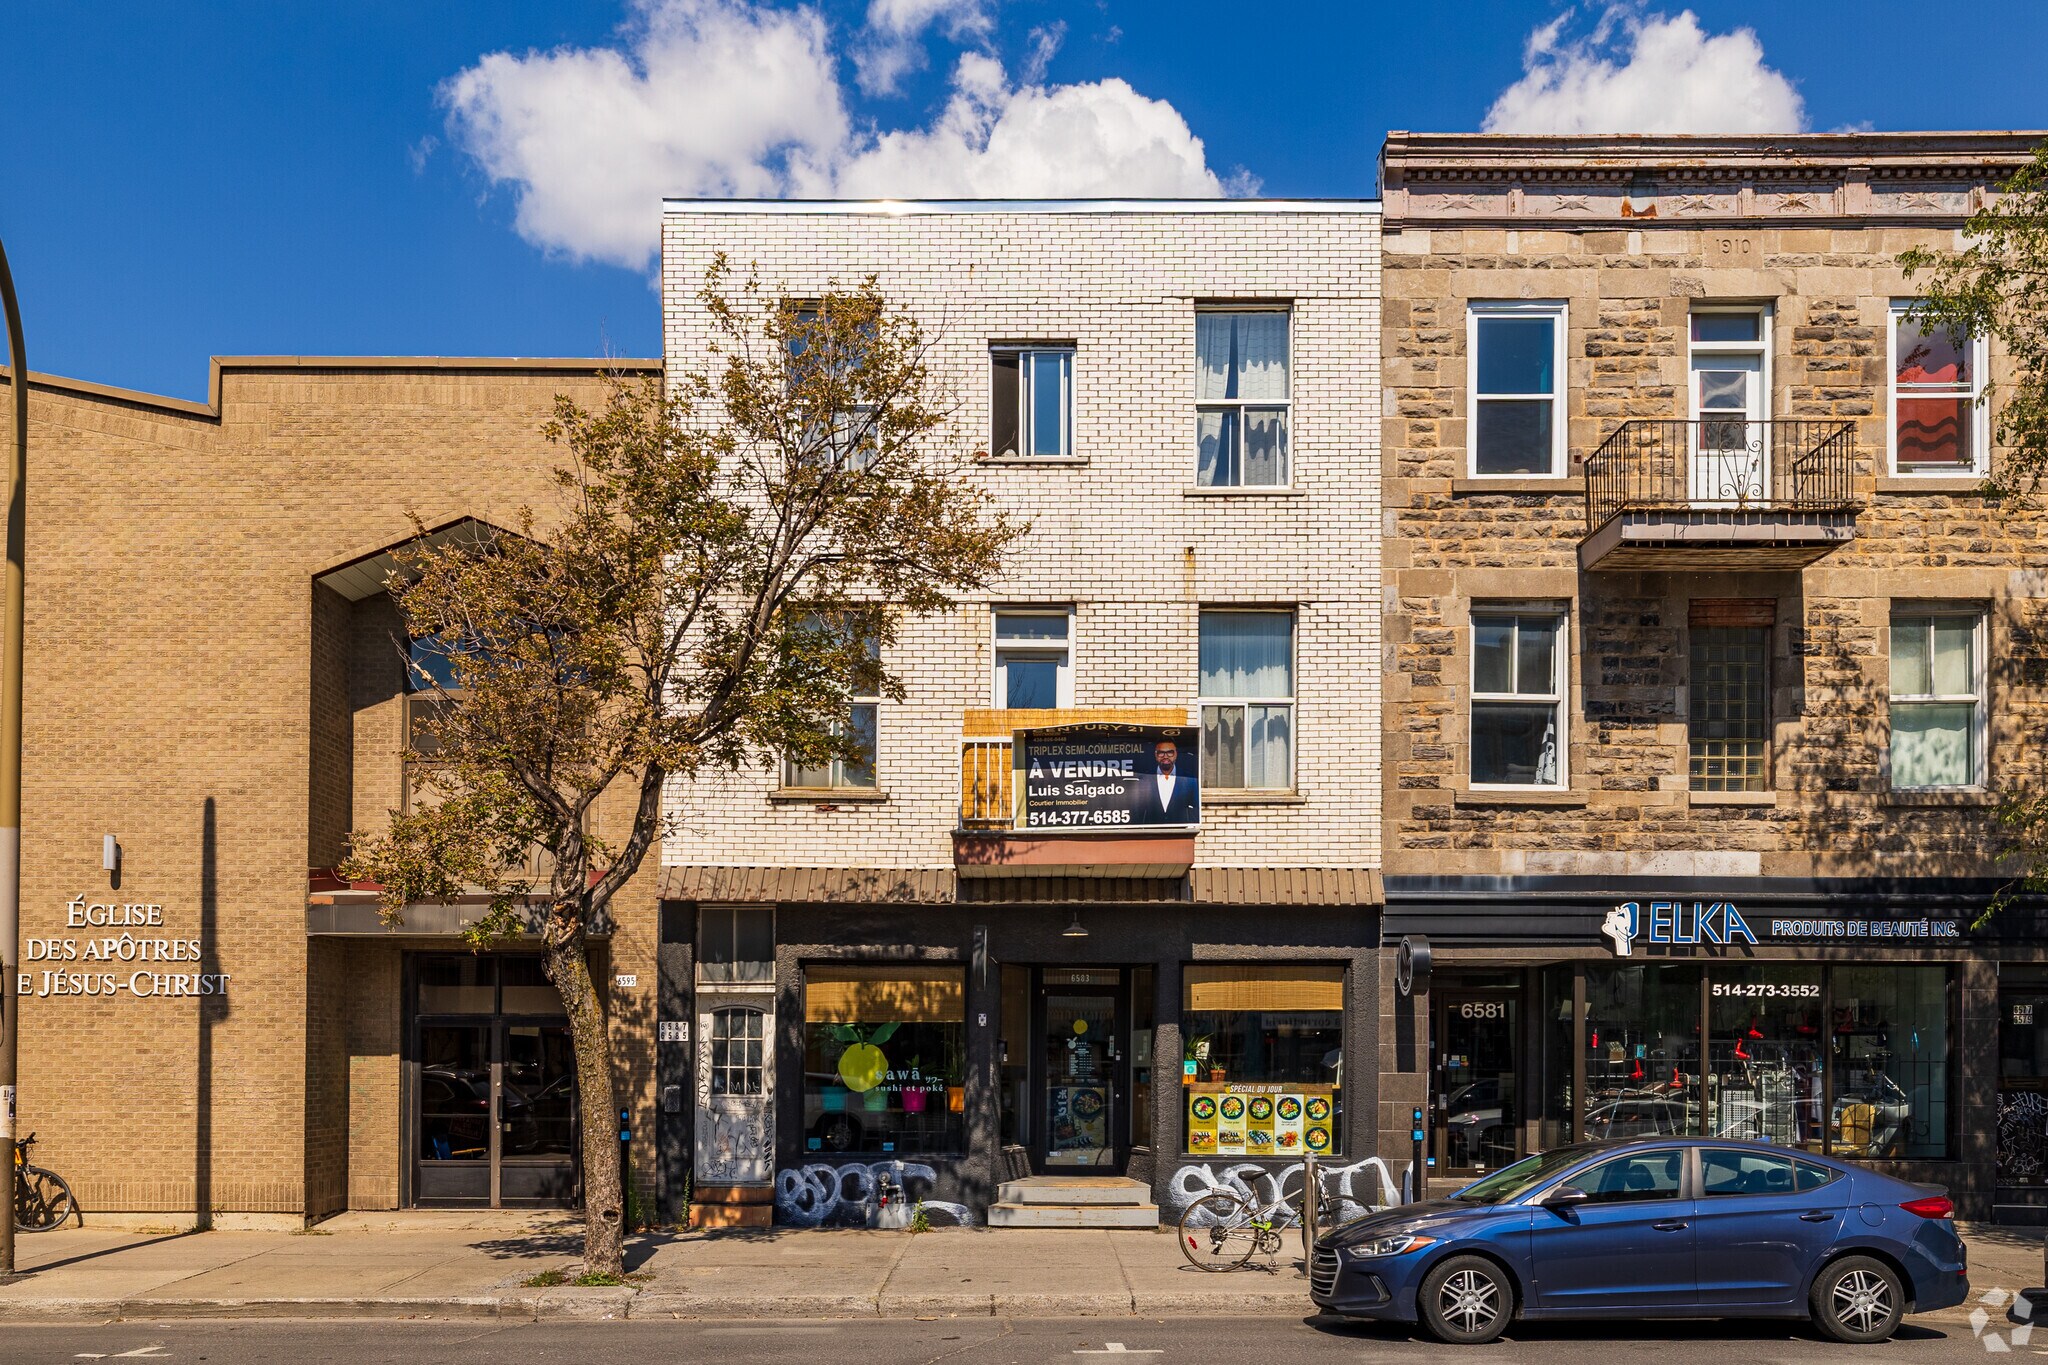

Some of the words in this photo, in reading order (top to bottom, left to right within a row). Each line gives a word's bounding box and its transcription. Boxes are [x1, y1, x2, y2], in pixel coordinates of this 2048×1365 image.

[1715, 238, 1751, 254] 1910
[1128, 725, 1144, 733] 21
[1029, 745, 1063, 757] TRIPLEX
[1065, 743, 1144, 756] SEMI-COMMERCIAL
[1028, 758, 1044, 779] À
[1048, 759, 1134, 779] VENDRE
[1028, 784, 1060, 797] Luis
[1064, 783, 1125, 798] Salgado
[1029, 809, 1131, 825] 514-377-6585
[66, 894, 163, 927] ÉGLISE
[1649, 902, 1759, 945] ELKA
[1772, 920, 1844, 937] PRODUITS
[1847, 920, 1868, 937] DE
[1871, 918, 1928, 937] BEAUTÉ
[1931, 920, 1960, 937] INC.
[27, 938, 77, 961] DES
[84, 933, 201, 961] APÔTRES
[18, 974, 33, 995] E
[38, 968, 231, 997] JÉSUS-CHRIST
[617, 976, 635, 986] 6595
[1071, 974, 1090, 983] 6583
[1712, 984, 1820, 998] 514-273-3552
[1461, 1003, 1505, 1018] 6581
[660, 1022, 687, 1031] 6587
[660, 1032, 687, 1040] 6585
[875, 1067, 920, 1081] sawā
[875, 1084, 902, 1092] sushi
[906, 1084, 917, 1092] et
[919, 1084, 944, 1094] poké
[1229, 1084, 1256, 1093] SPÉCIAL
[1257, 1085, 1266, 1093] DU
[1266, 1085, 1283, 1093] JOUR
